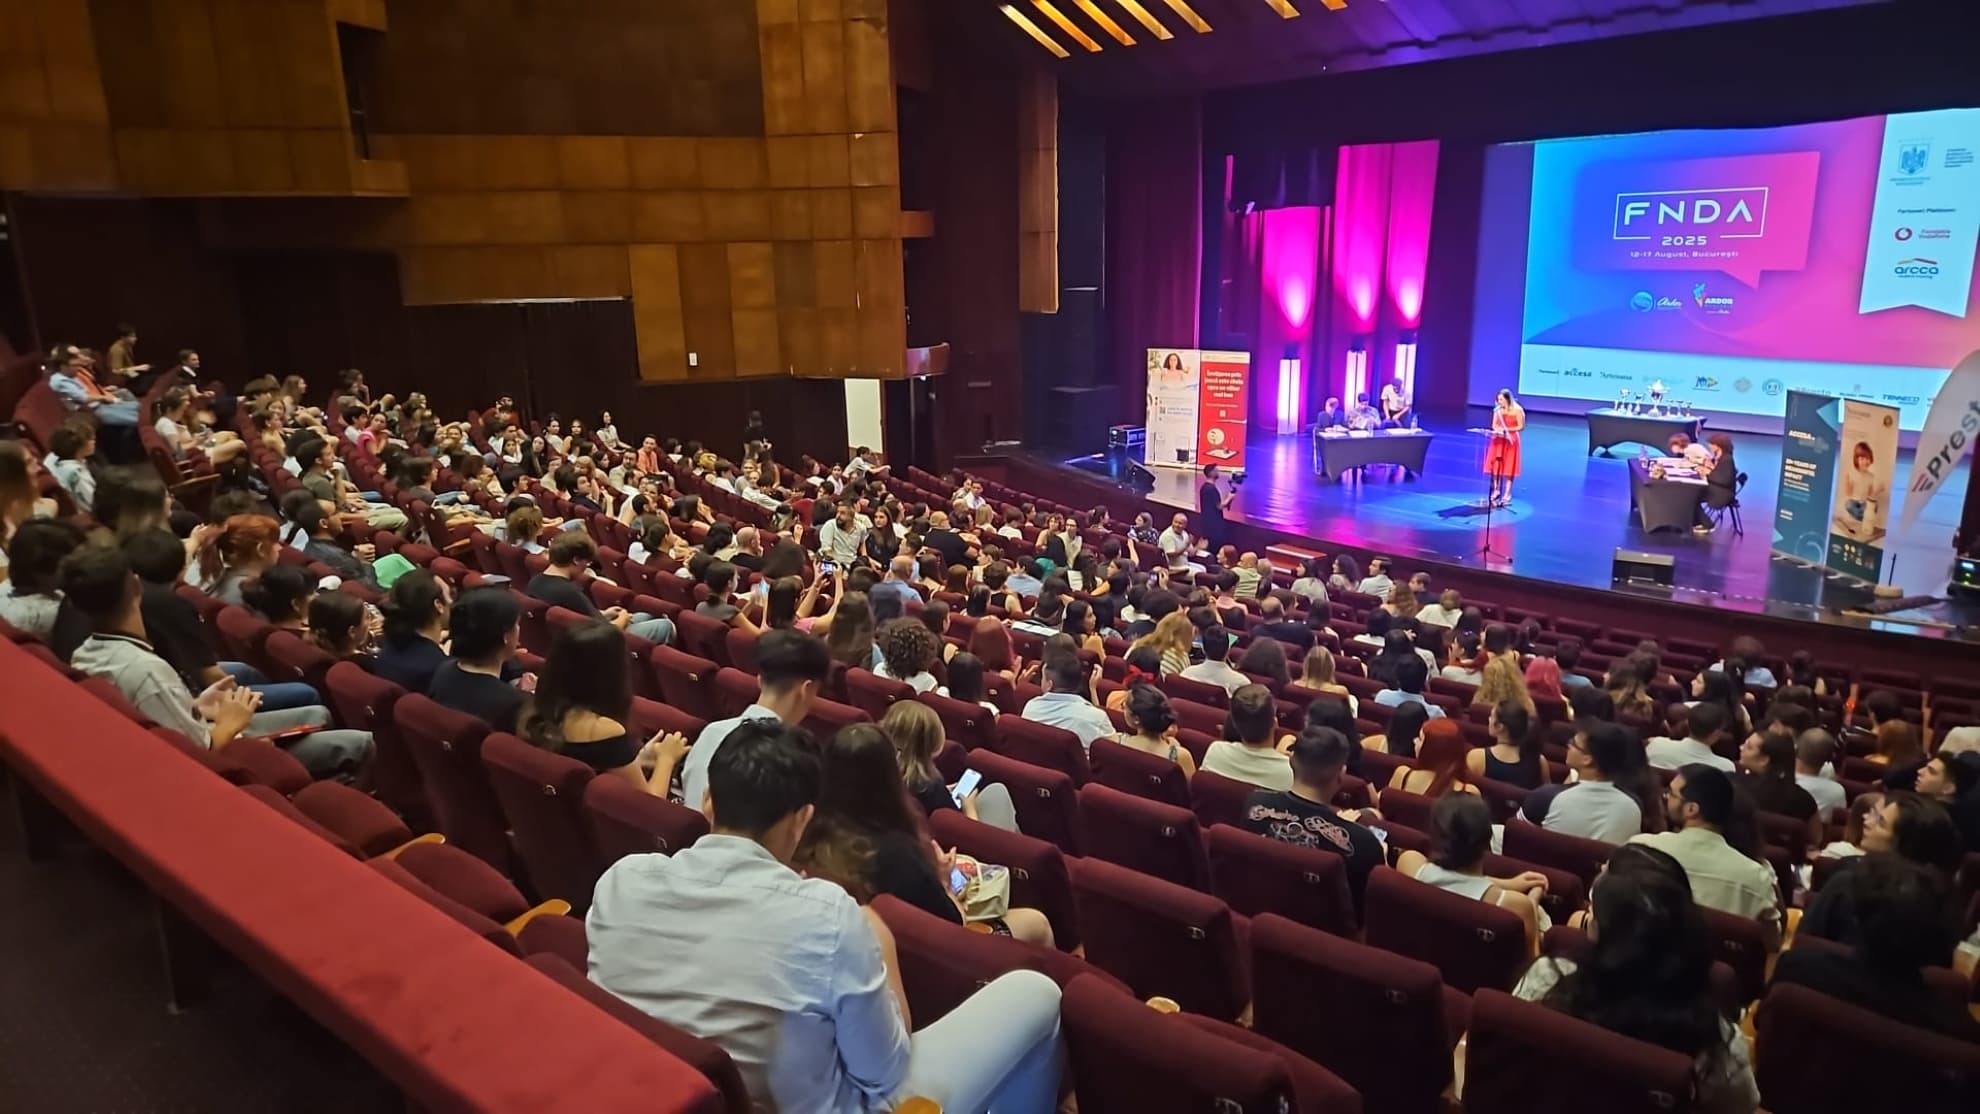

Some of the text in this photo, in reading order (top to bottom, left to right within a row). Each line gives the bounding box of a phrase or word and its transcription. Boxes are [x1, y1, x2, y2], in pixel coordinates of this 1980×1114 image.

[1624, 199, 1753, 225] FNDA
[1661, 235, 1708, 247] 2025
[1654, 250, 1690, 259] August,
